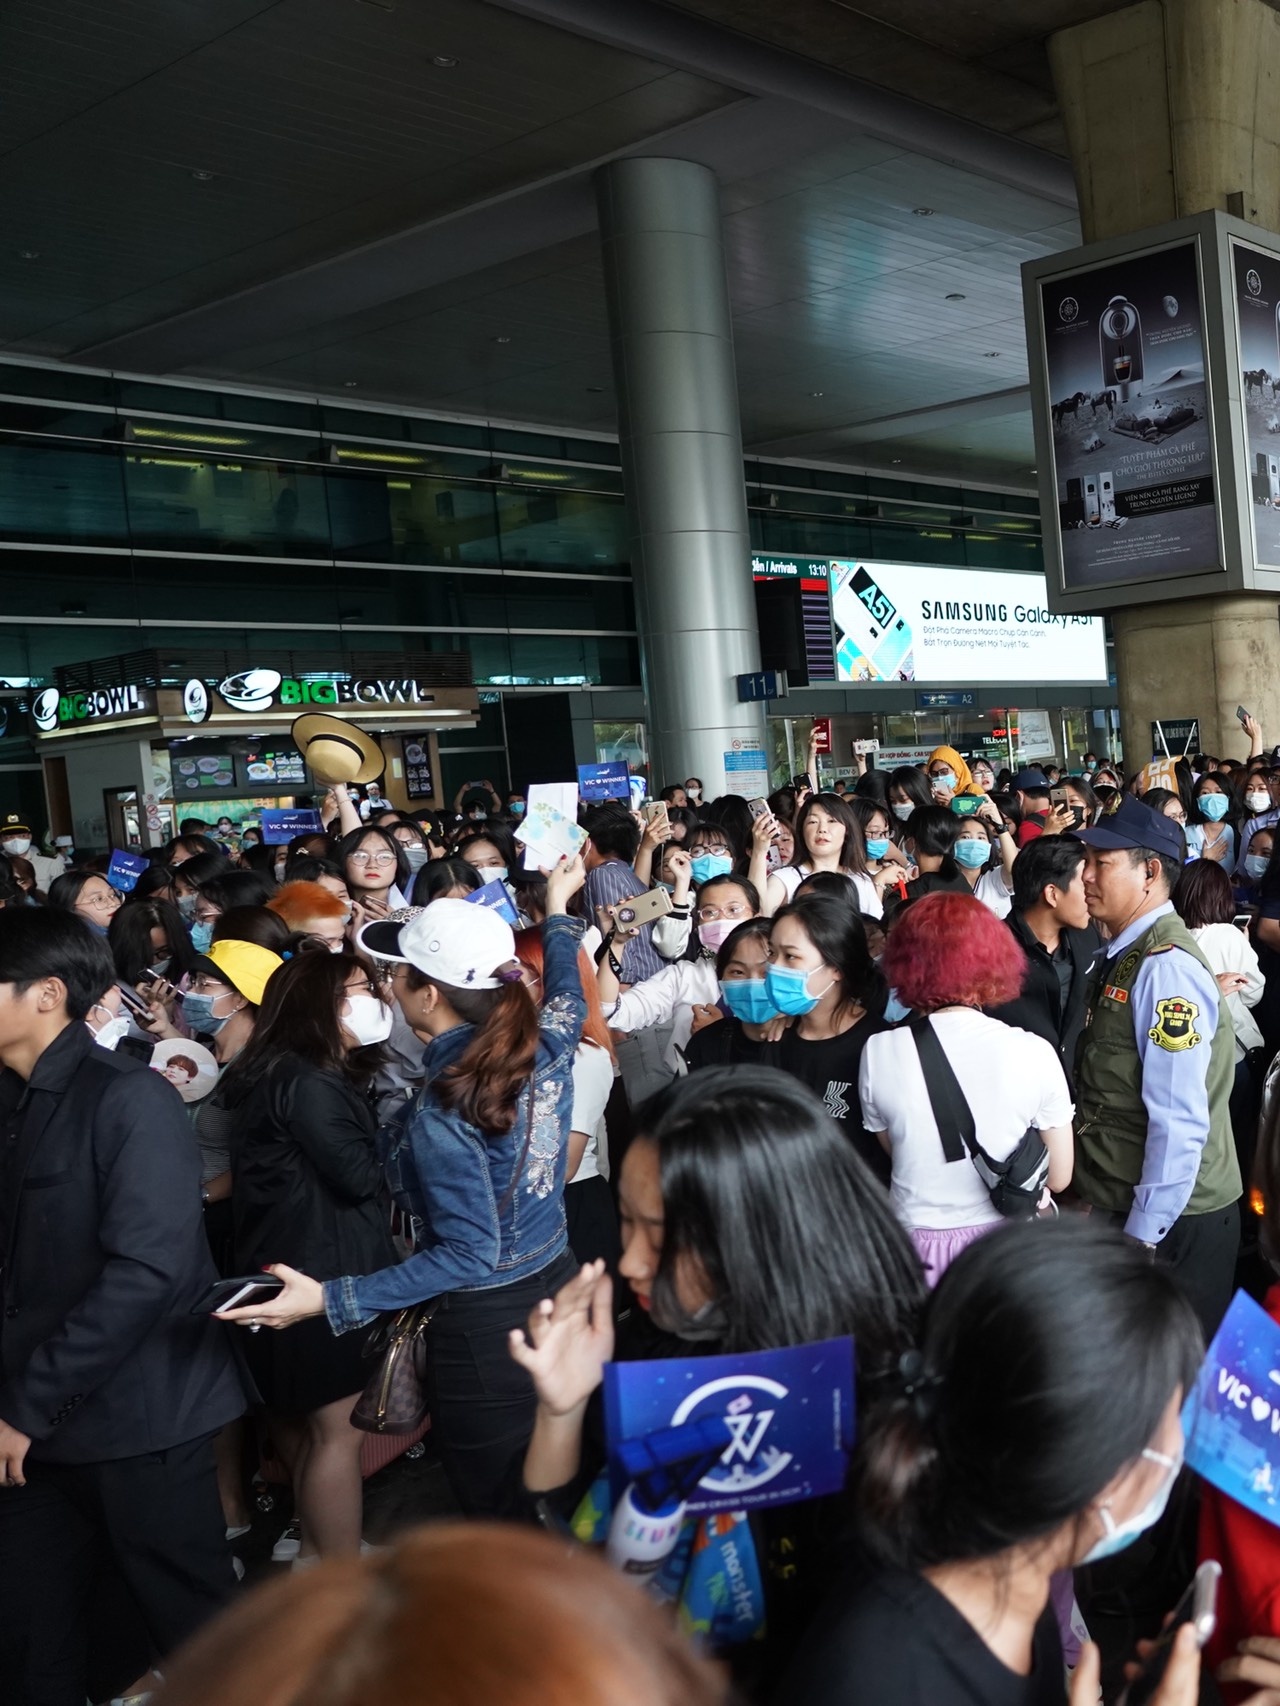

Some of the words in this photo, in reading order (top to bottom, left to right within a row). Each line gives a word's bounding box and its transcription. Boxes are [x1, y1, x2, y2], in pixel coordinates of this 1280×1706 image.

[770, 561, 797, 575] Arrivals
[808, 564, 827, 576] 13:10
[921, 600, 1008, 622] SAMSUNG
[950, 627, 977, 636] Camera
[978, 628, 998, 636] Macro
[281, 679, 435, 705] BIGBOWL
[749, 676, 766, 696] 11
[59, 685, 145, 721] BIGBOWL
[962, 695, 972, 703] A2
[602, 775, 627, 784] WINNER
[1217, 1367, 1252, 1410] VIC
[720, 1539, 755, 1622] monster
